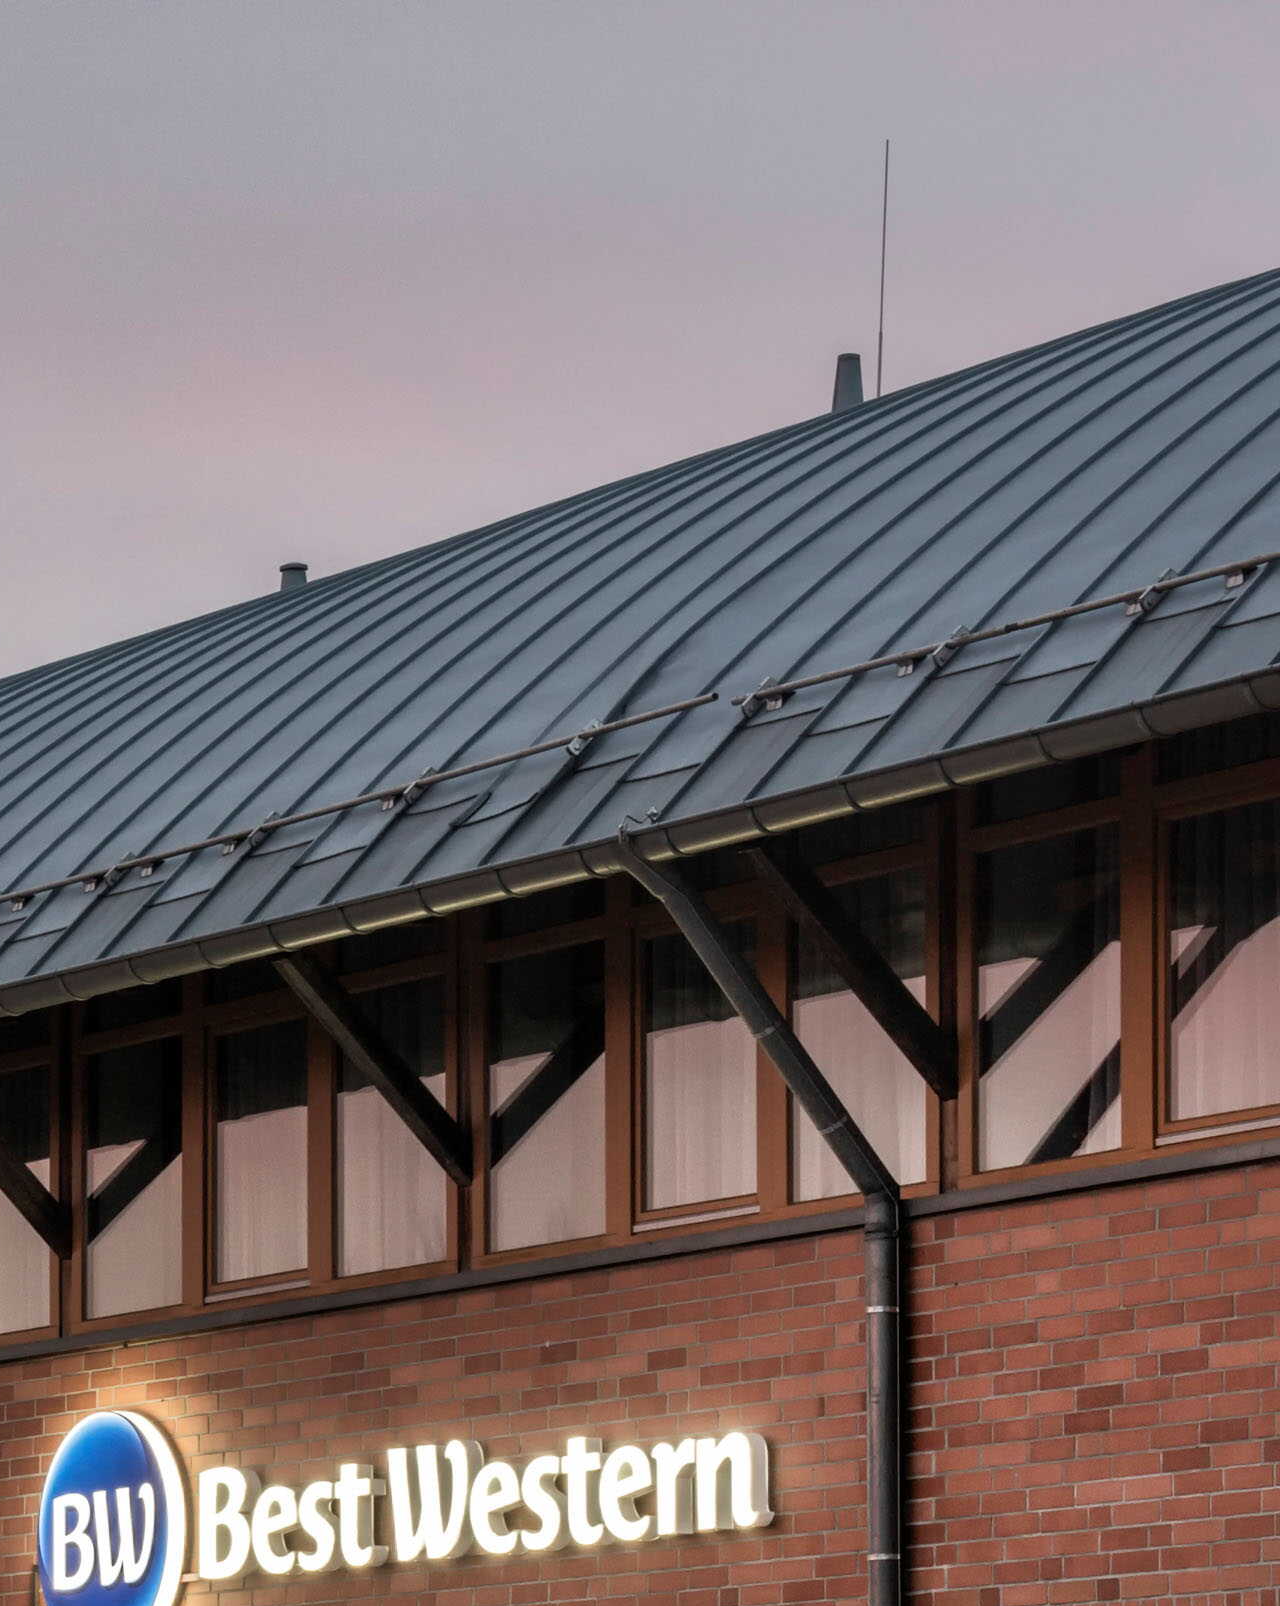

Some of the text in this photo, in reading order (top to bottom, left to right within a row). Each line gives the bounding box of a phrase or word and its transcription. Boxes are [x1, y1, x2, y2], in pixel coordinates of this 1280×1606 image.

[51, 1486, 154, 1592] BW
[198, 1431, 774, 1581] Best Western
